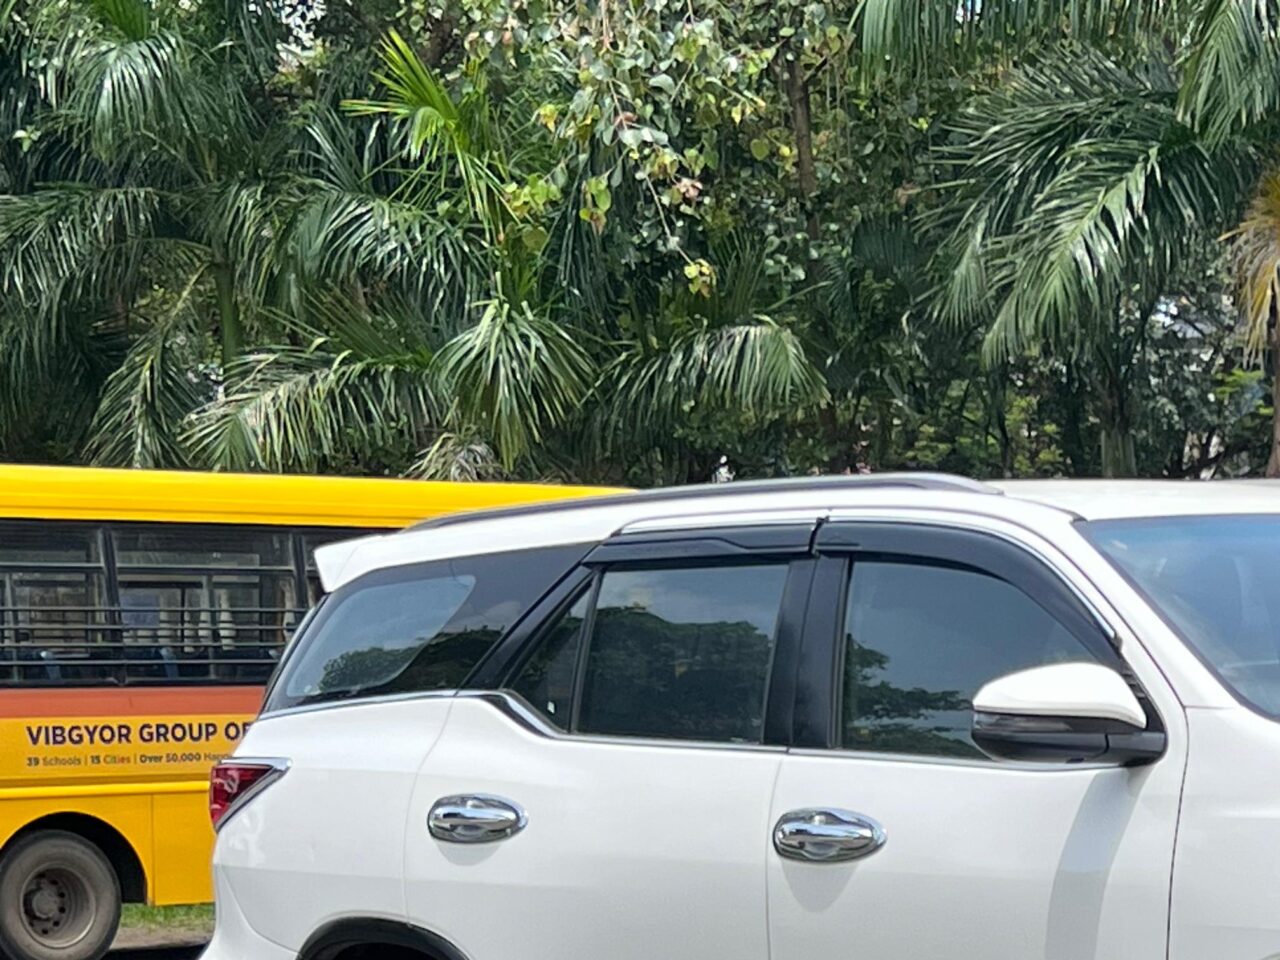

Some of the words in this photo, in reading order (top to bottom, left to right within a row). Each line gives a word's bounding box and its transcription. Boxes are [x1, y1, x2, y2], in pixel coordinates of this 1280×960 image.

[25, 725, 132, 746] VIBGYOR
[139, 722, 218, 743] GROUP
[27, 756, 40, 767] 39
[42, 755, 82, 767] Schools
[103, 754, 131, 765] Cities
[139, 754, 163, 764] Over
